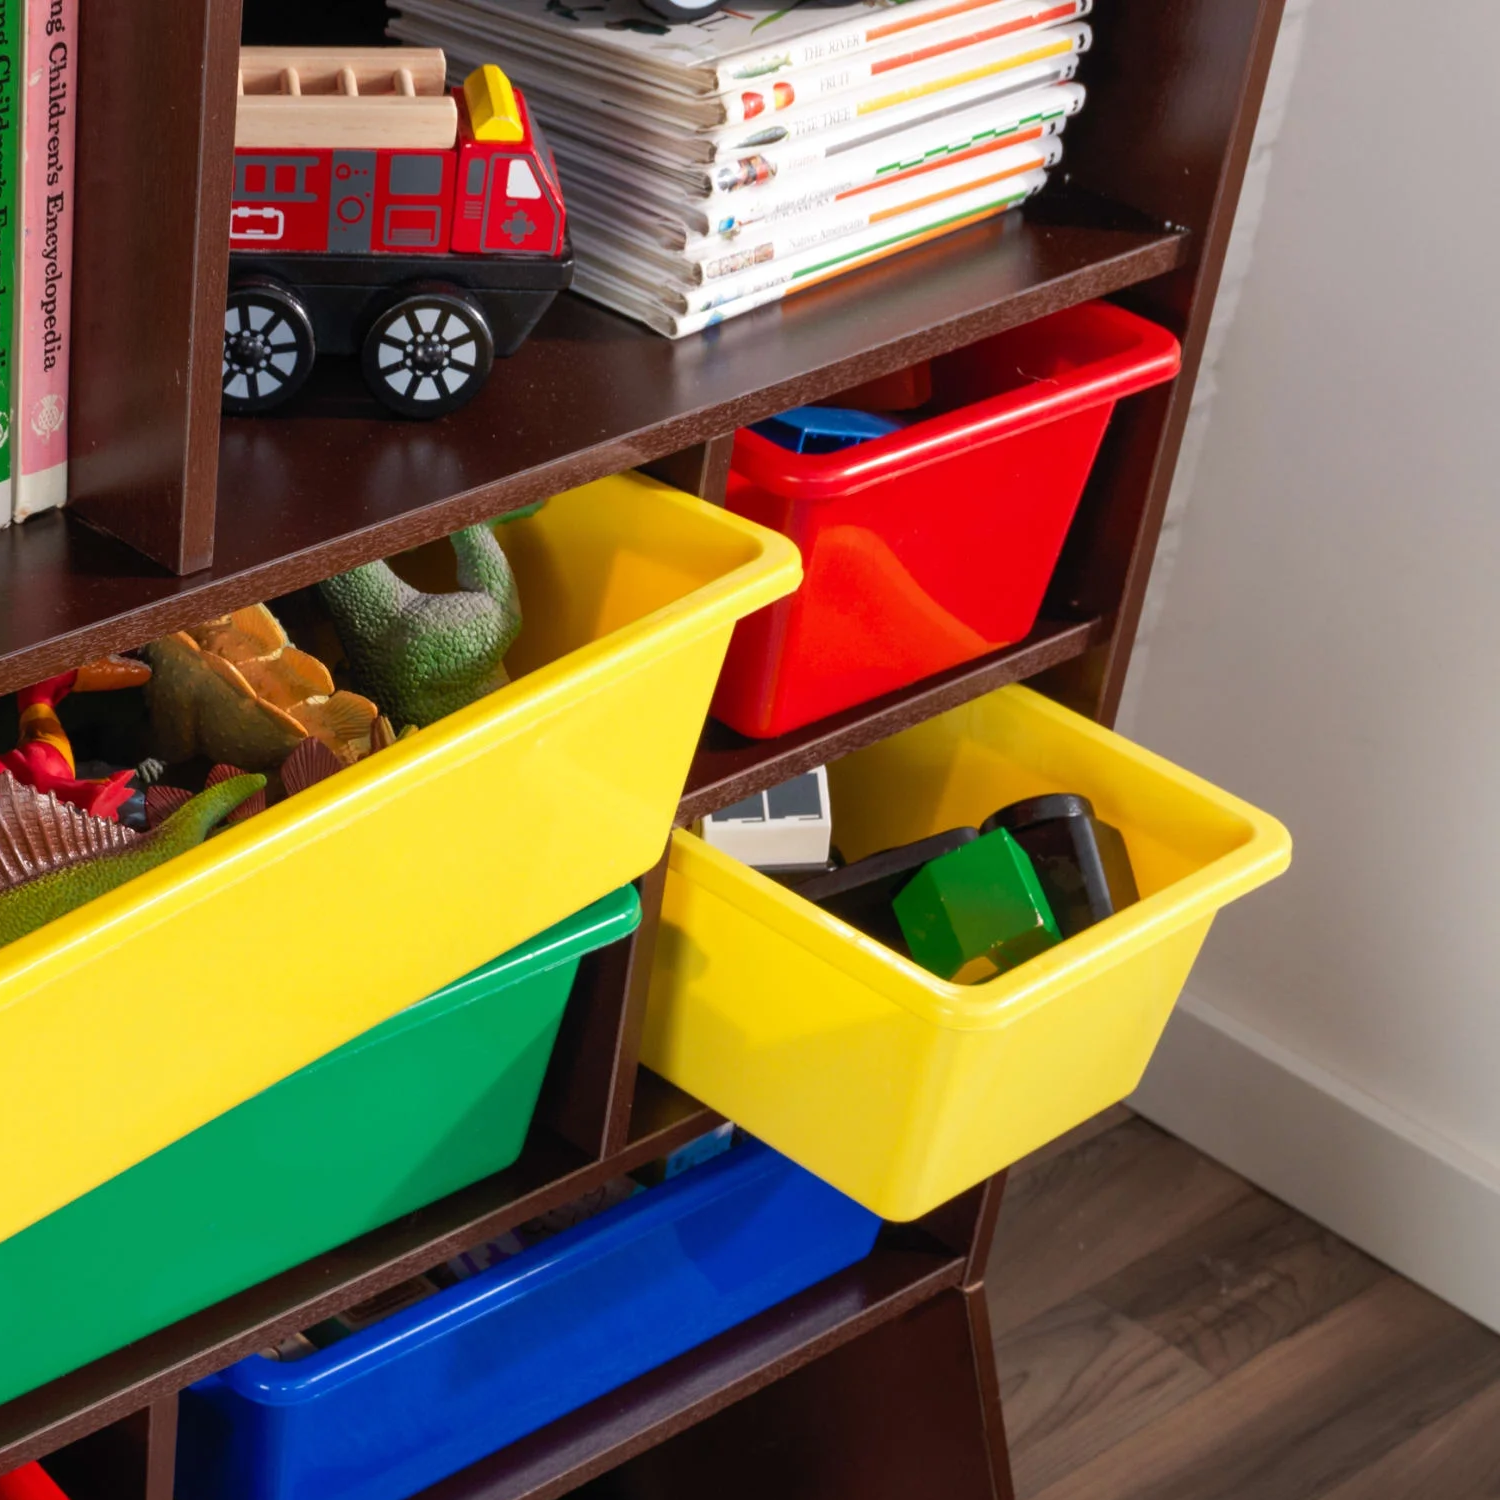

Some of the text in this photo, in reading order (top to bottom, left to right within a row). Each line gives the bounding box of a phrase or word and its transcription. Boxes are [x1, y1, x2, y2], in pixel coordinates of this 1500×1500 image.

[828, 35, 860, 54] RIVER
[820, 72, 850, 91] FRUIT
[47, 42, 67, 186] Children's
[823, 108, 850, 128] TREE
[40, 191, 64, 372] Encyclopedia
